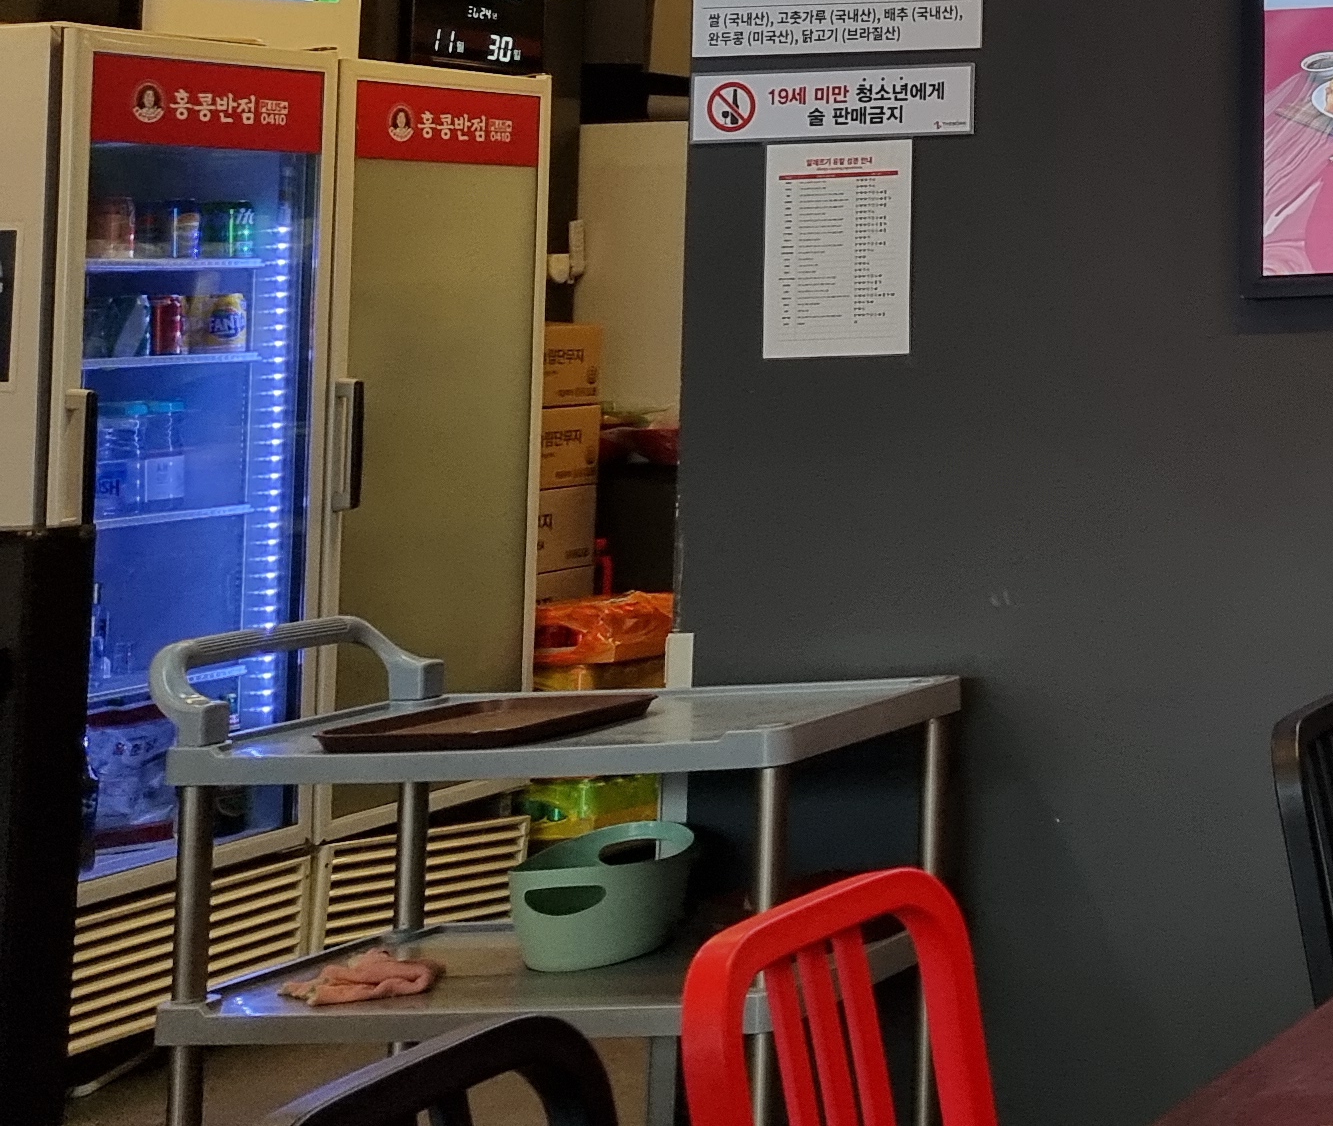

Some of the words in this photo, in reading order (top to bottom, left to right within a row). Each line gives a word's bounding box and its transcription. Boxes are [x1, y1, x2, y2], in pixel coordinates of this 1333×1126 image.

[709, 13, 720, 28] 쌀
[723, 11, 775, 28] (국내산),
[777, 10, 827, 25] 고춧가루
[829, 8, 881, 26] (국내산),
[884, 7, 908, 22] 배추
[911, 5, 963, 23] (국내산),
[708, 31, 744, 47] 완두콩
[747, 29, 799, 46] (미국산),
[802, 27, 838, 44] 닭고기
[842, 26, 901, 43] (브라질산)
[768, 86, 807, 105] 19세
[814, 85, 849, 104] 미만
[856, 80, 945, 103] 청소년에게
[170, 89, 256, 124] 홍콩반점
[807, 107, 826, 126] 술
[832, 105, 904, 125] 판매금지
[261, 115, 286, 125] 0410
[417, 110, 486, 142] 홍콩반점
